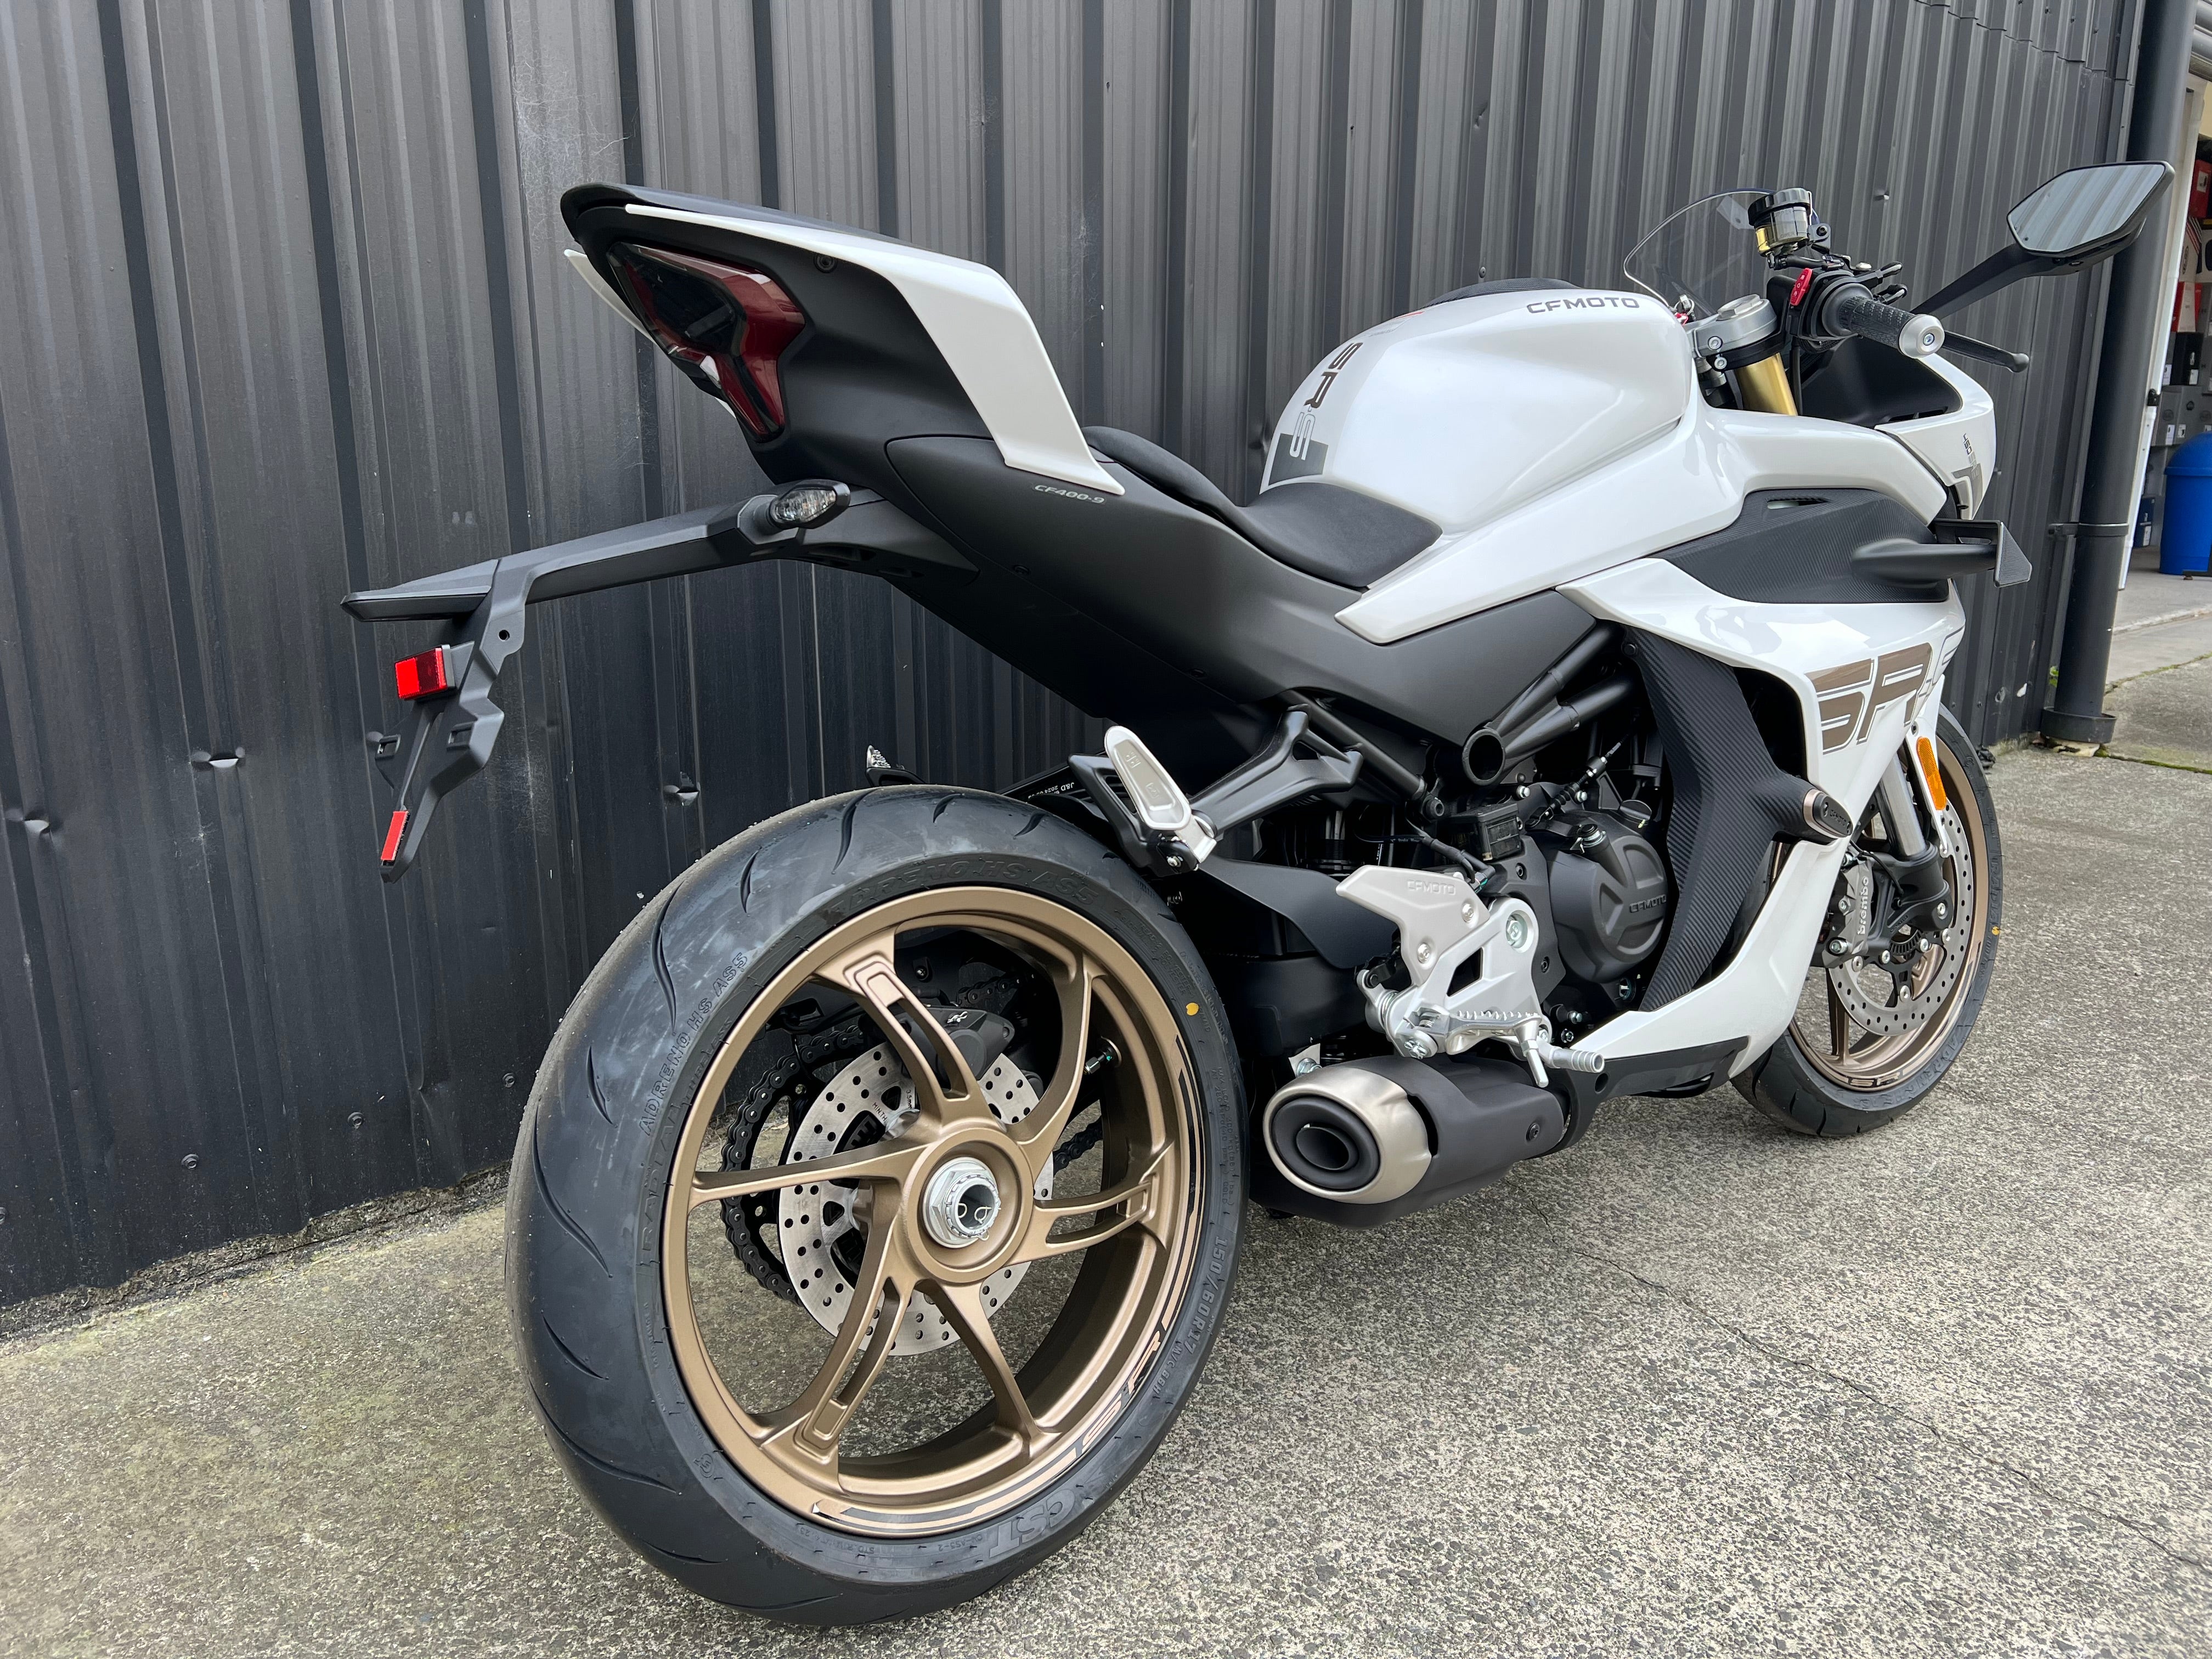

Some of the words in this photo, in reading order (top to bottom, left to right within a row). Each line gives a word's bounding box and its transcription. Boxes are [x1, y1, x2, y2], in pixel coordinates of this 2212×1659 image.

[1527, 297, 1640, 314] CFMOTO
[1035, 484, 1105, 504] CF400-9
[1407, 879, 1456, 896] CFMOTO
[1629, 894, 1667, 913] CFMOTO
[1857, 876, 1870, 935] brembo
[637, 1029, 692, 1136] ADRENO
[686, 994, 714, 1031] HS
[709, 950, 748, 998] AS5
[1185, 1236, 1229, 1357] 150/60R17
[1166, 1342, 1183, 1369] M/C
[1152, 1364, 1170, 1395] 66H
[989, 1488, 1076, 1559] CST
